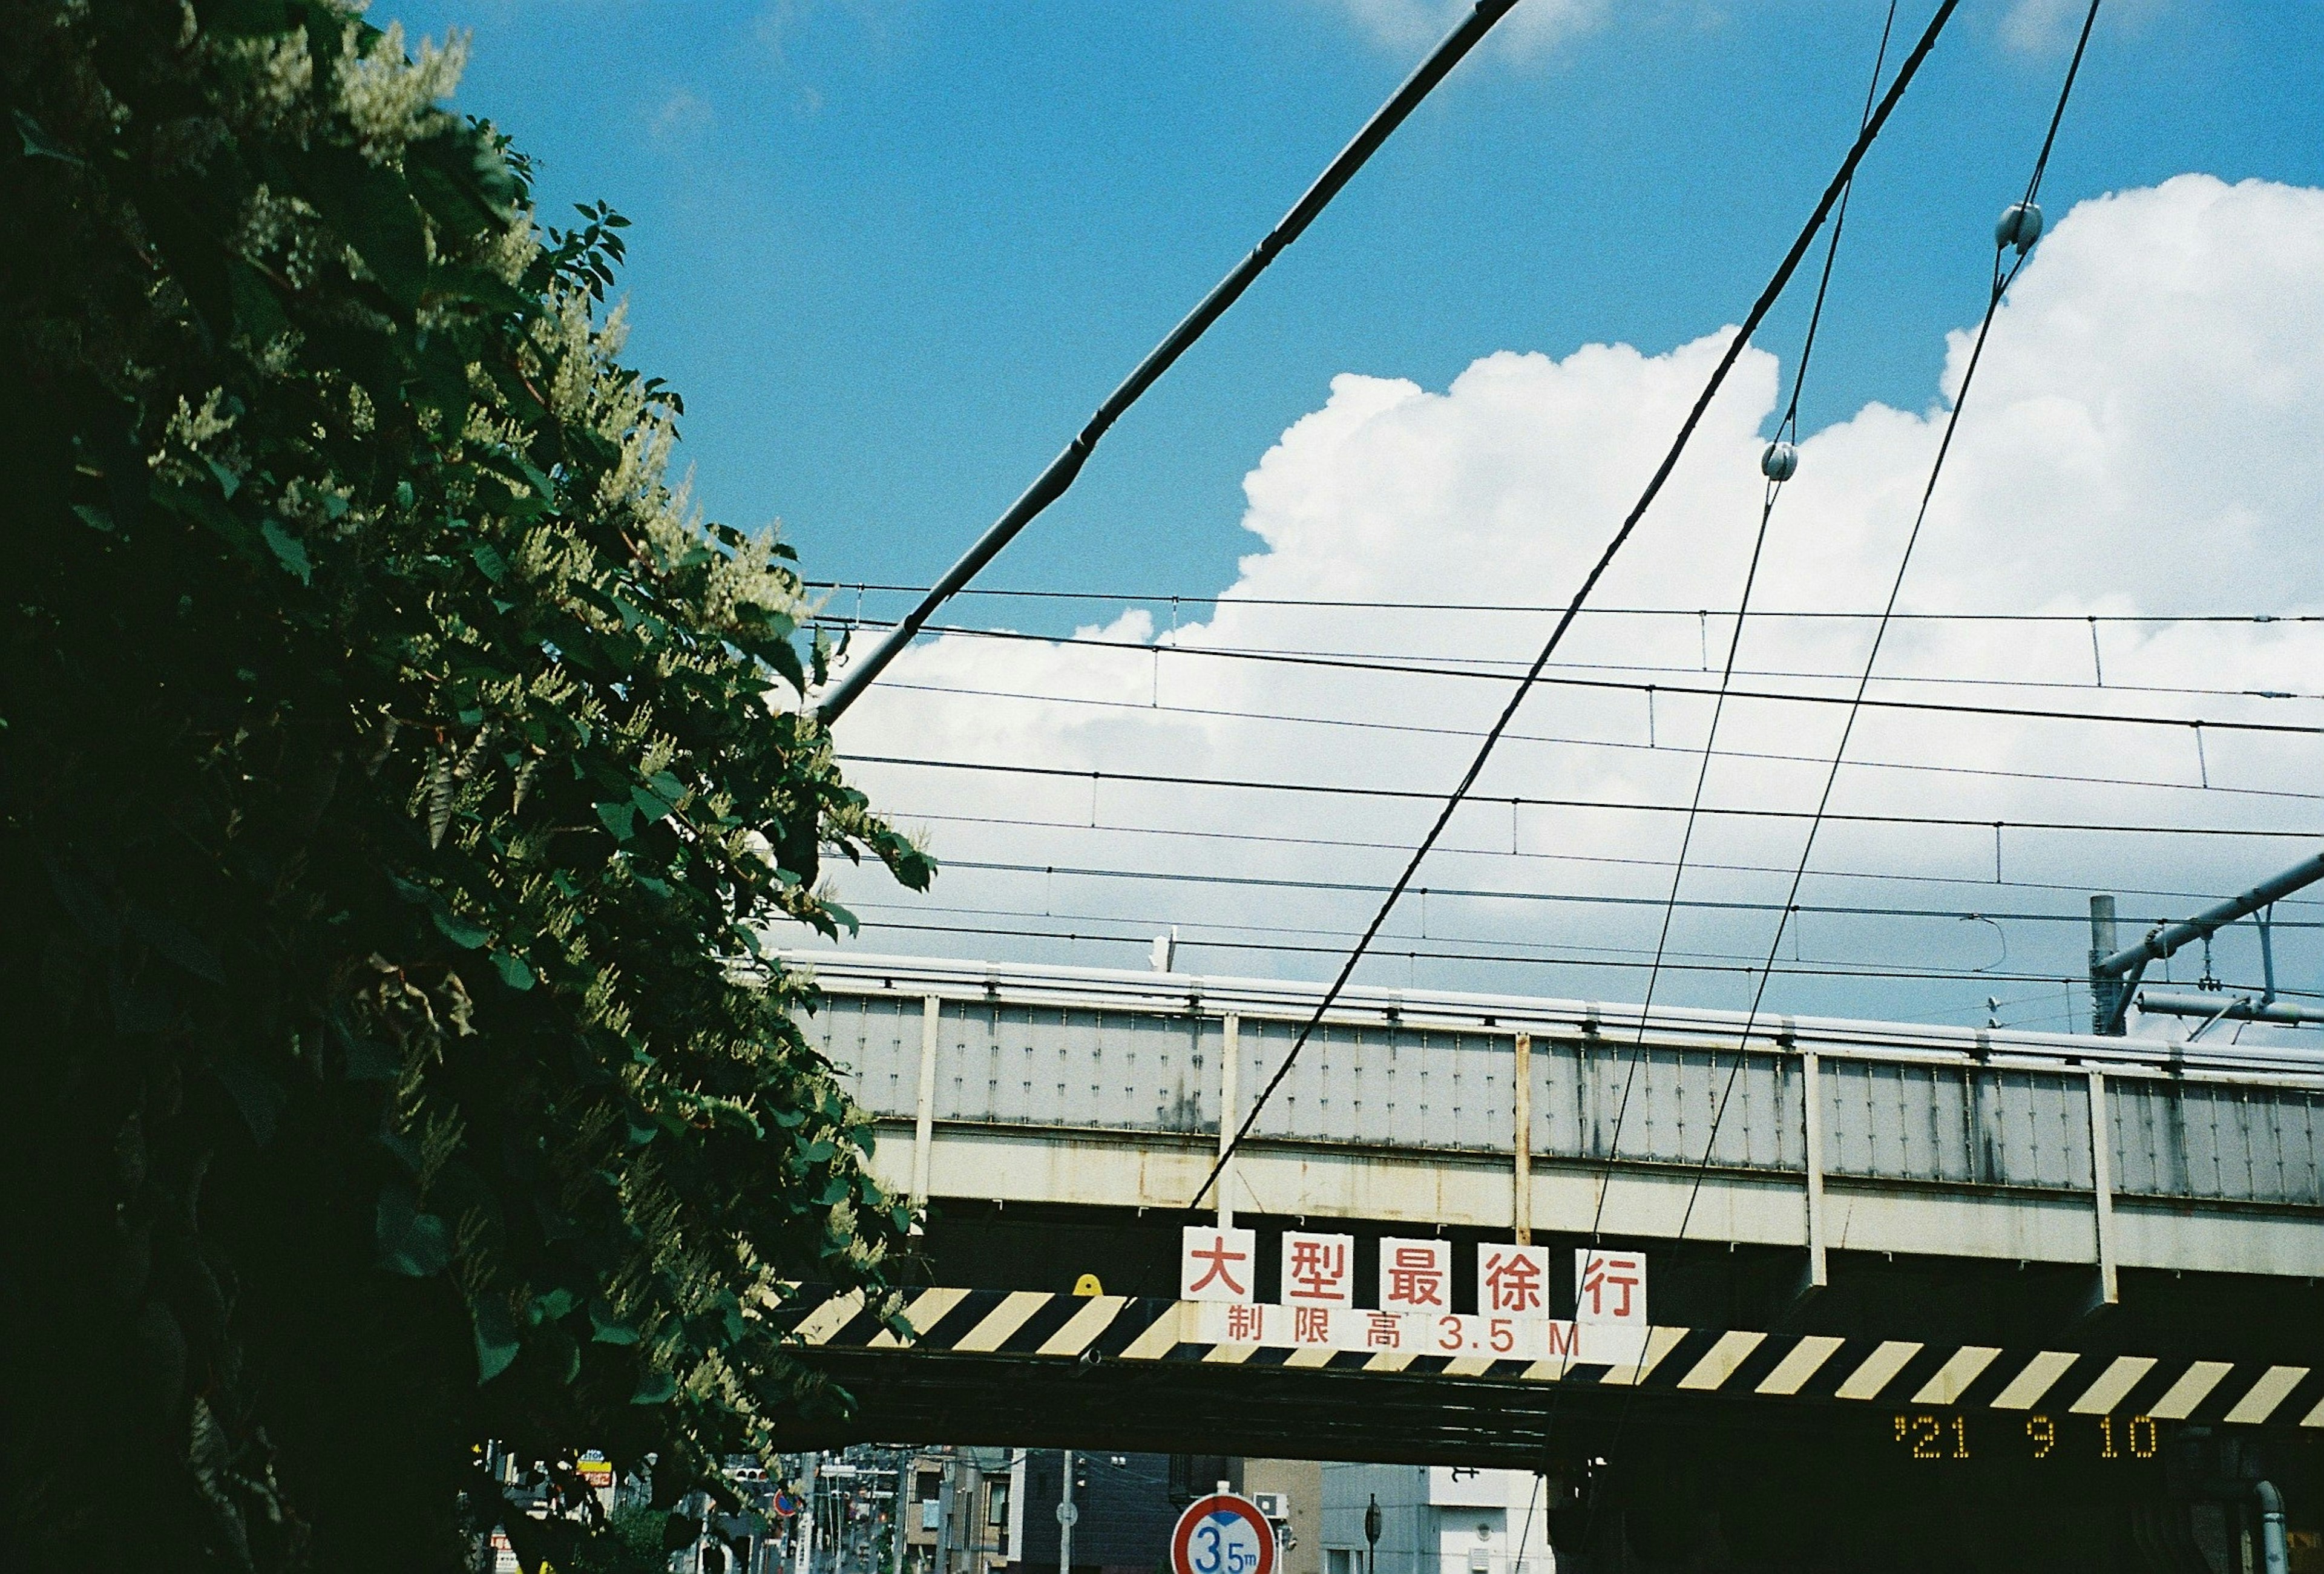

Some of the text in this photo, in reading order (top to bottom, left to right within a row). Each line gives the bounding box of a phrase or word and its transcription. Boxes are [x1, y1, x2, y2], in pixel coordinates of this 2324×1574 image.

[1190, 1236, 1639, 1316] 大型最徐行
